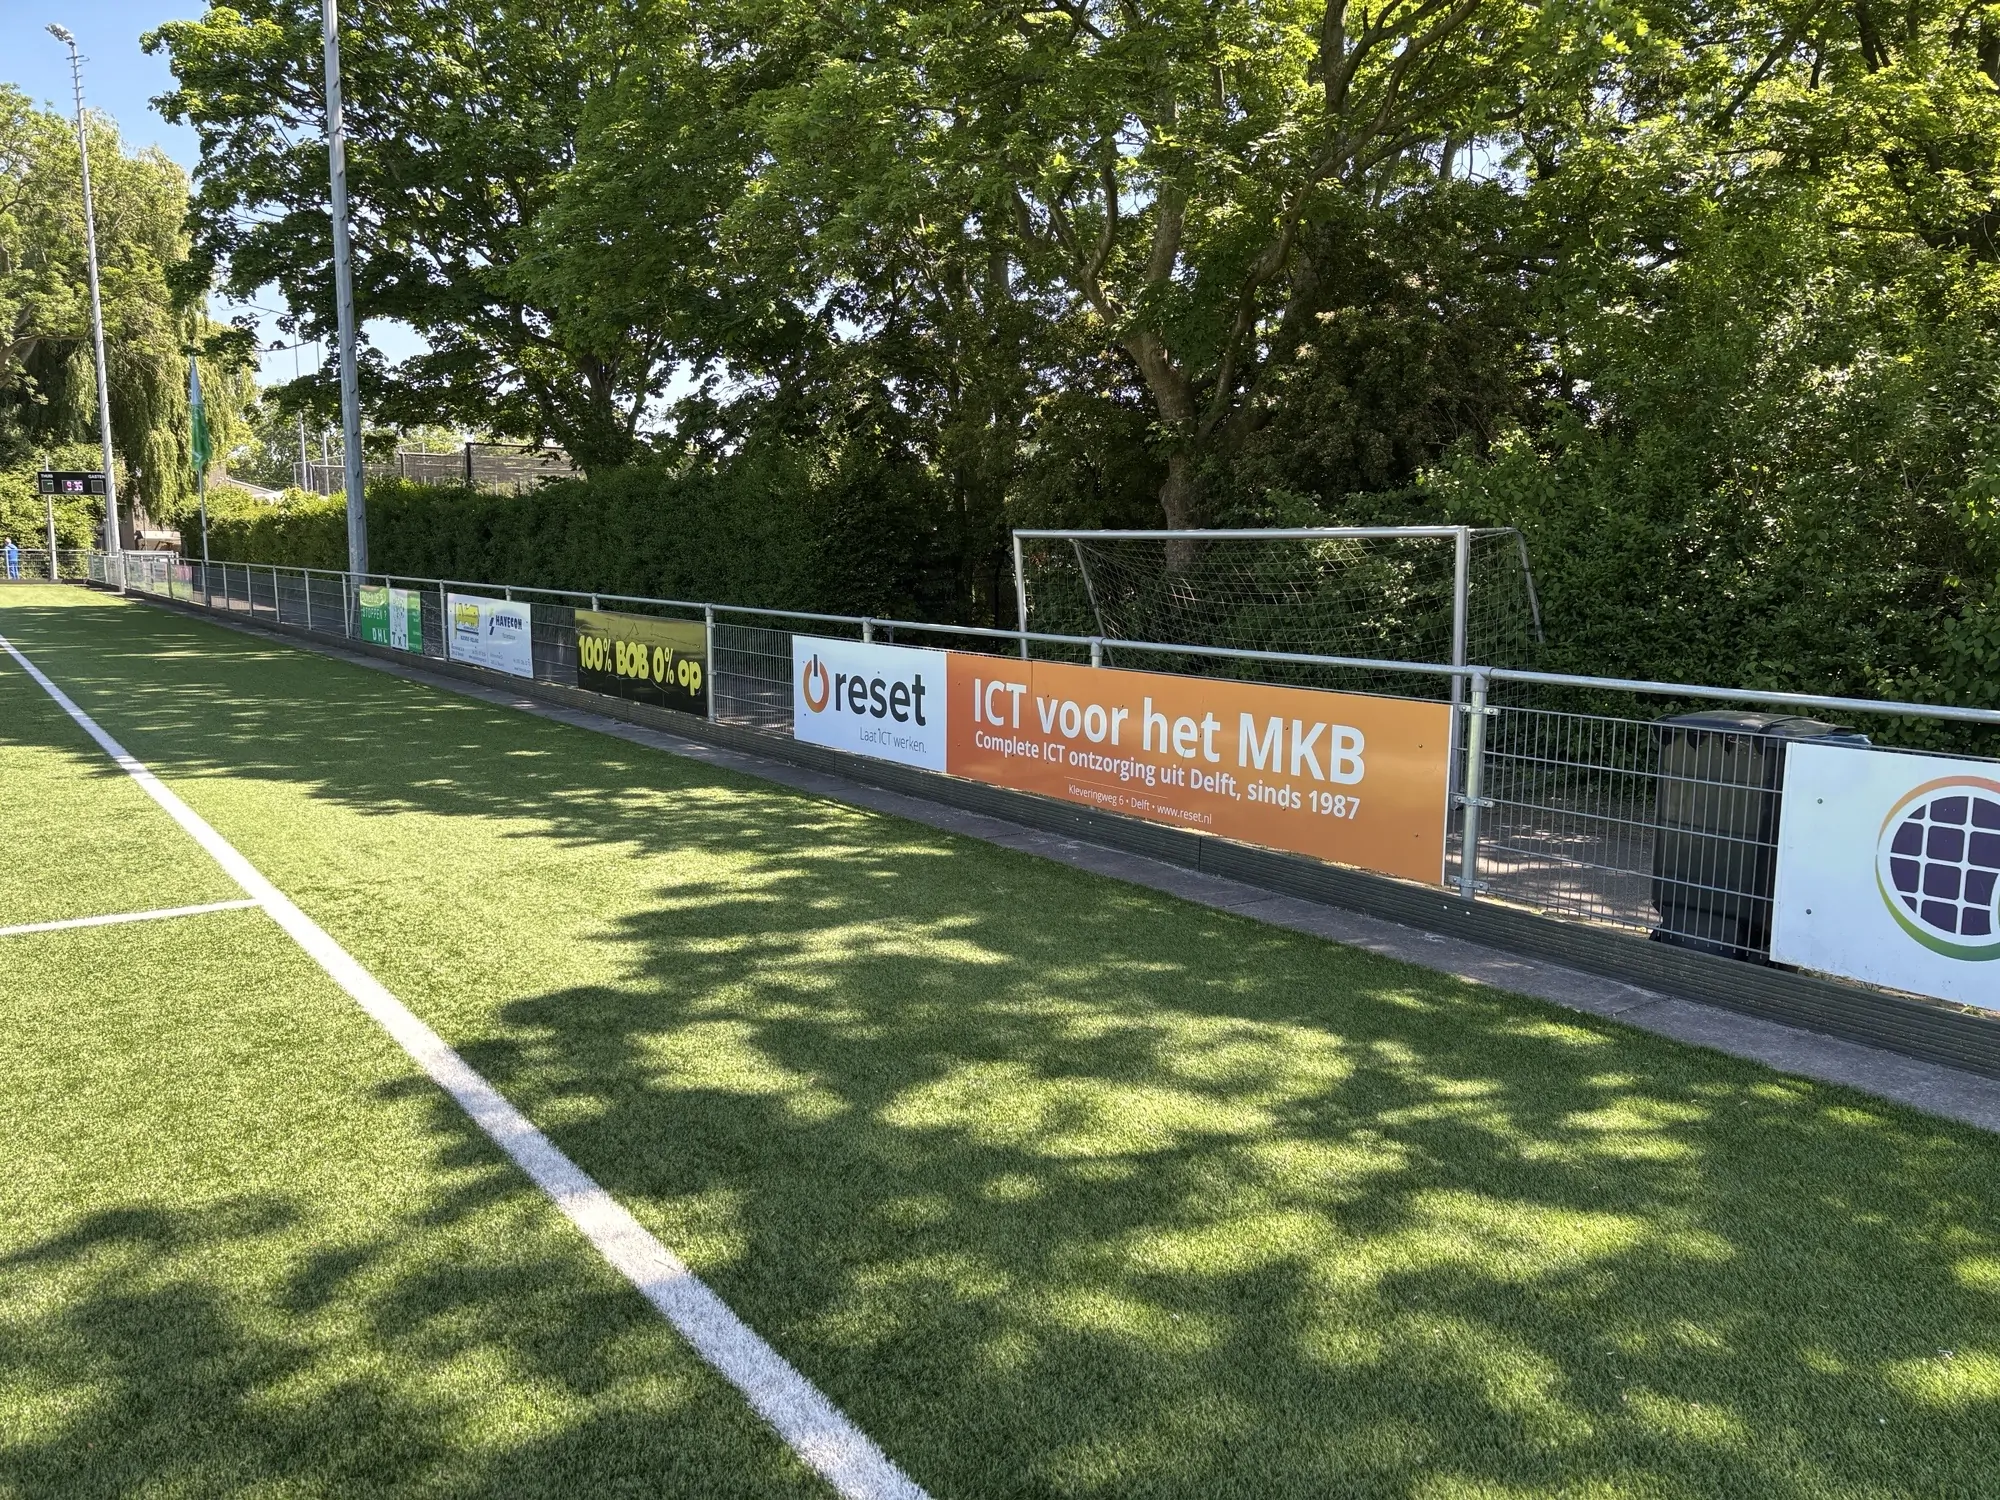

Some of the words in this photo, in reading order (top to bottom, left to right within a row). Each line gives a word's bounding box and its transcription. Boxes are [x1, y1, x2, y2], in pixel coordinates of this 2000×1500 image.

[579, 635, 612, 672] 100%
[615, 641, 649, 679] BOB
[653, 646, 674, 684] 0%
[677, 660, 701, 696] op
[835, 673, 926, 726] reset
[860, 727, 877, 743] Laat
[878, 729, 892, 745] ICT
[893, 735, 926, 753] werken.
[974, 678, 1027, 729] ICT
[1036, 697, 1129, 745] voor
[1143, 697, 1221, 763] het
[1238, 712, 1365, 785] MKB
[975, 730, 1039, 759] Complete
[1043, 741, 1065, 763] ICT
[1069, 750, 1156, 787] ontzorging
[1160, 764, 1185, 787] uit
[1191, 769, 1241, 801] Delft,
[1247, 780, 1301, 809] sinds
[1308, 790, 1360, 820] 1987
[1068, 784, 1117, 807] Kleveringweg
[1118, 796, 1124, 805] 6
[1131, 798, 1150, 811] Delft
[1157, 804, 1212, 825] www.reset.nl
